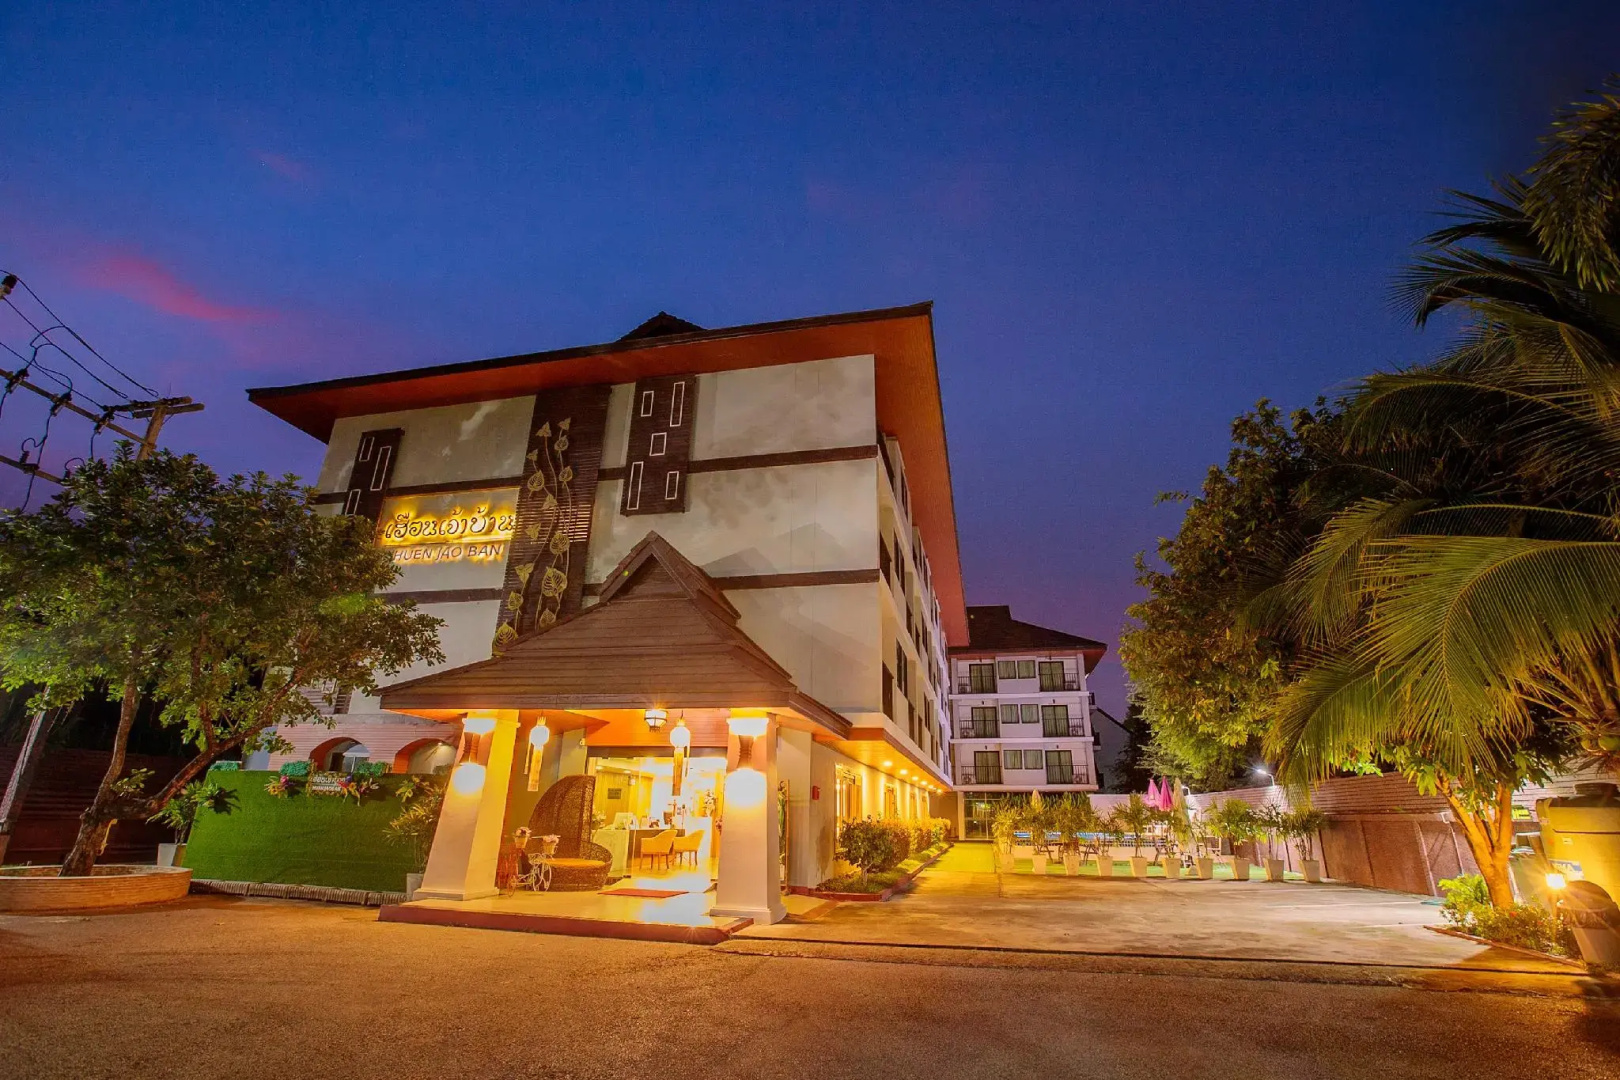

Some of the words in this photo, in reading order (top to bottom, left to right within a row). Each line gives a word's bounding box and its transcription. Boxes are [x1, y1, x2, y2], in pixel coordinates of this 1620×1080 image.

[393, 548, 433, 561] HUEN
[435, 546, 462, 561] JAO
[467, 544, 502, 557] BAN
